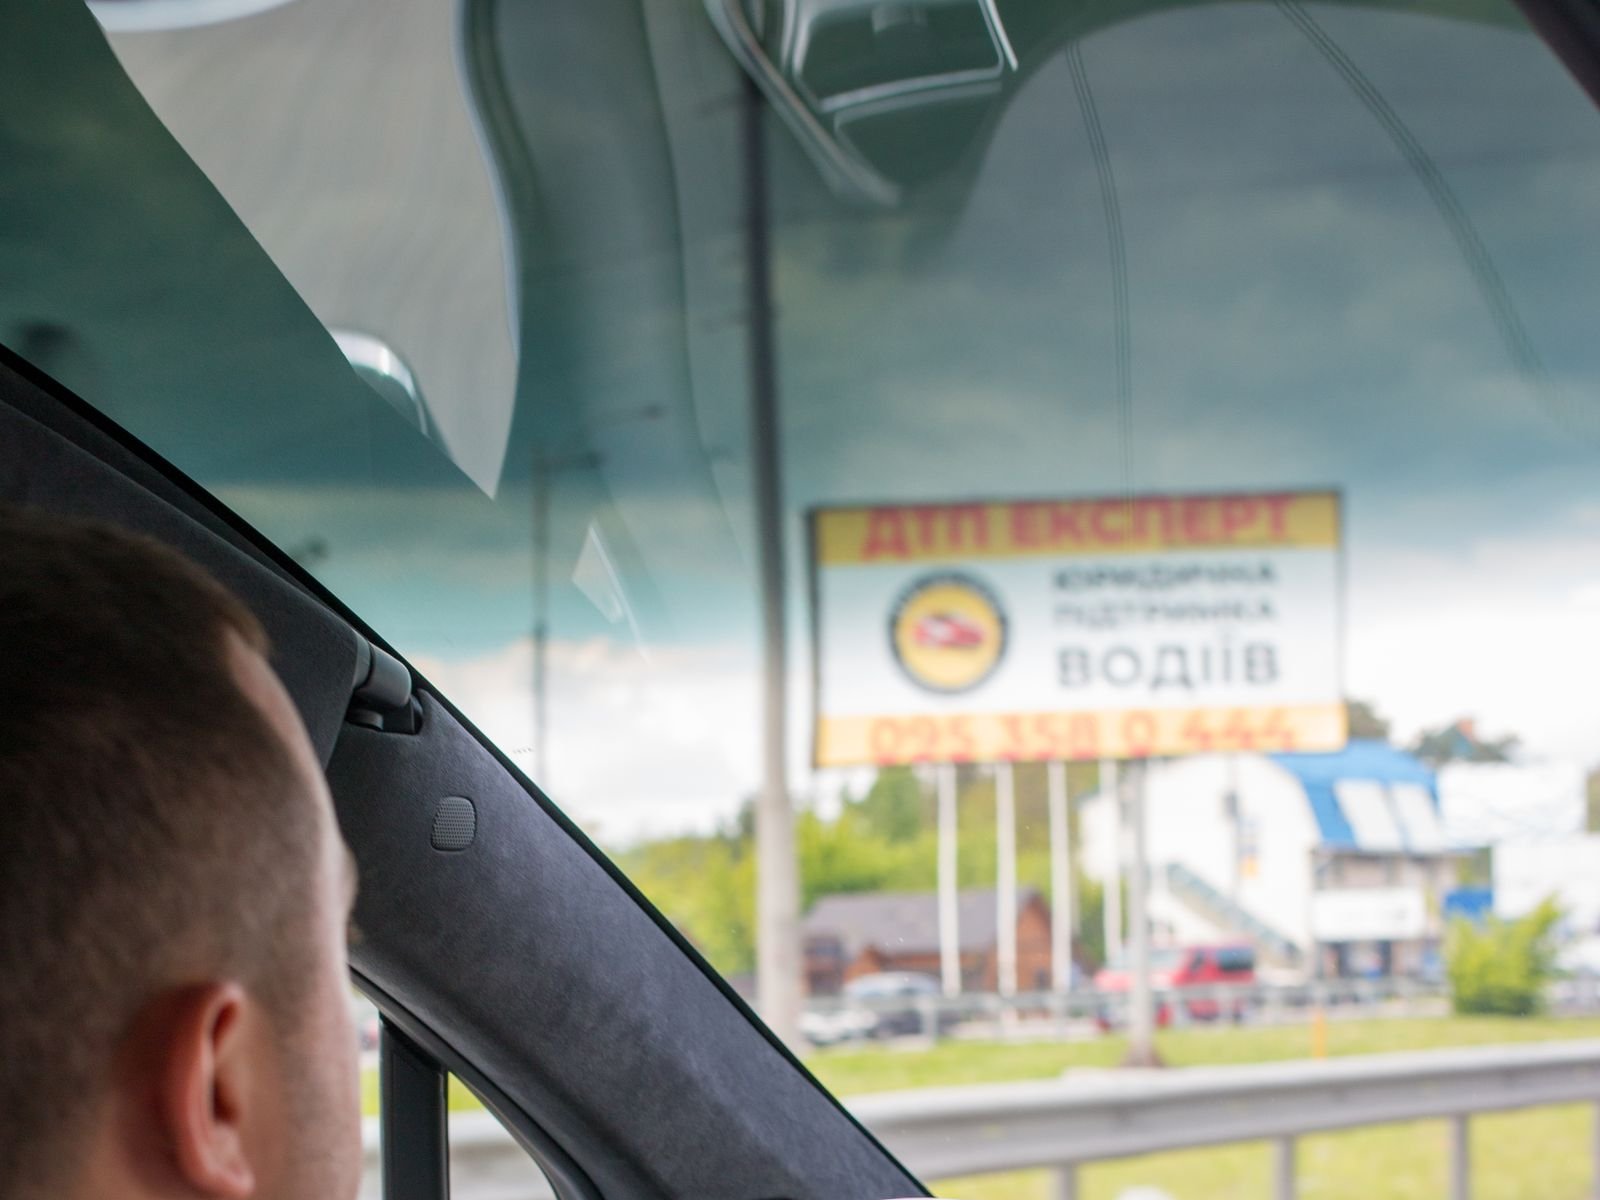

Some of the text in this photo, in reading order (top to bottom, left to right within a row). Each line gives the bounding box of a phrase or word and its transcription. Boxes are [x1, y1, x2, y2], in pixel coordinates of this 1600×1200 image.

[860, 494, 1295, 561] ДТП ЕКСПЕРТ
[1056, 636, 1280, 690] ВОДІЇВ
[870, 716, 975, 765] 095
[1180, 708, 1297, 753] 444
